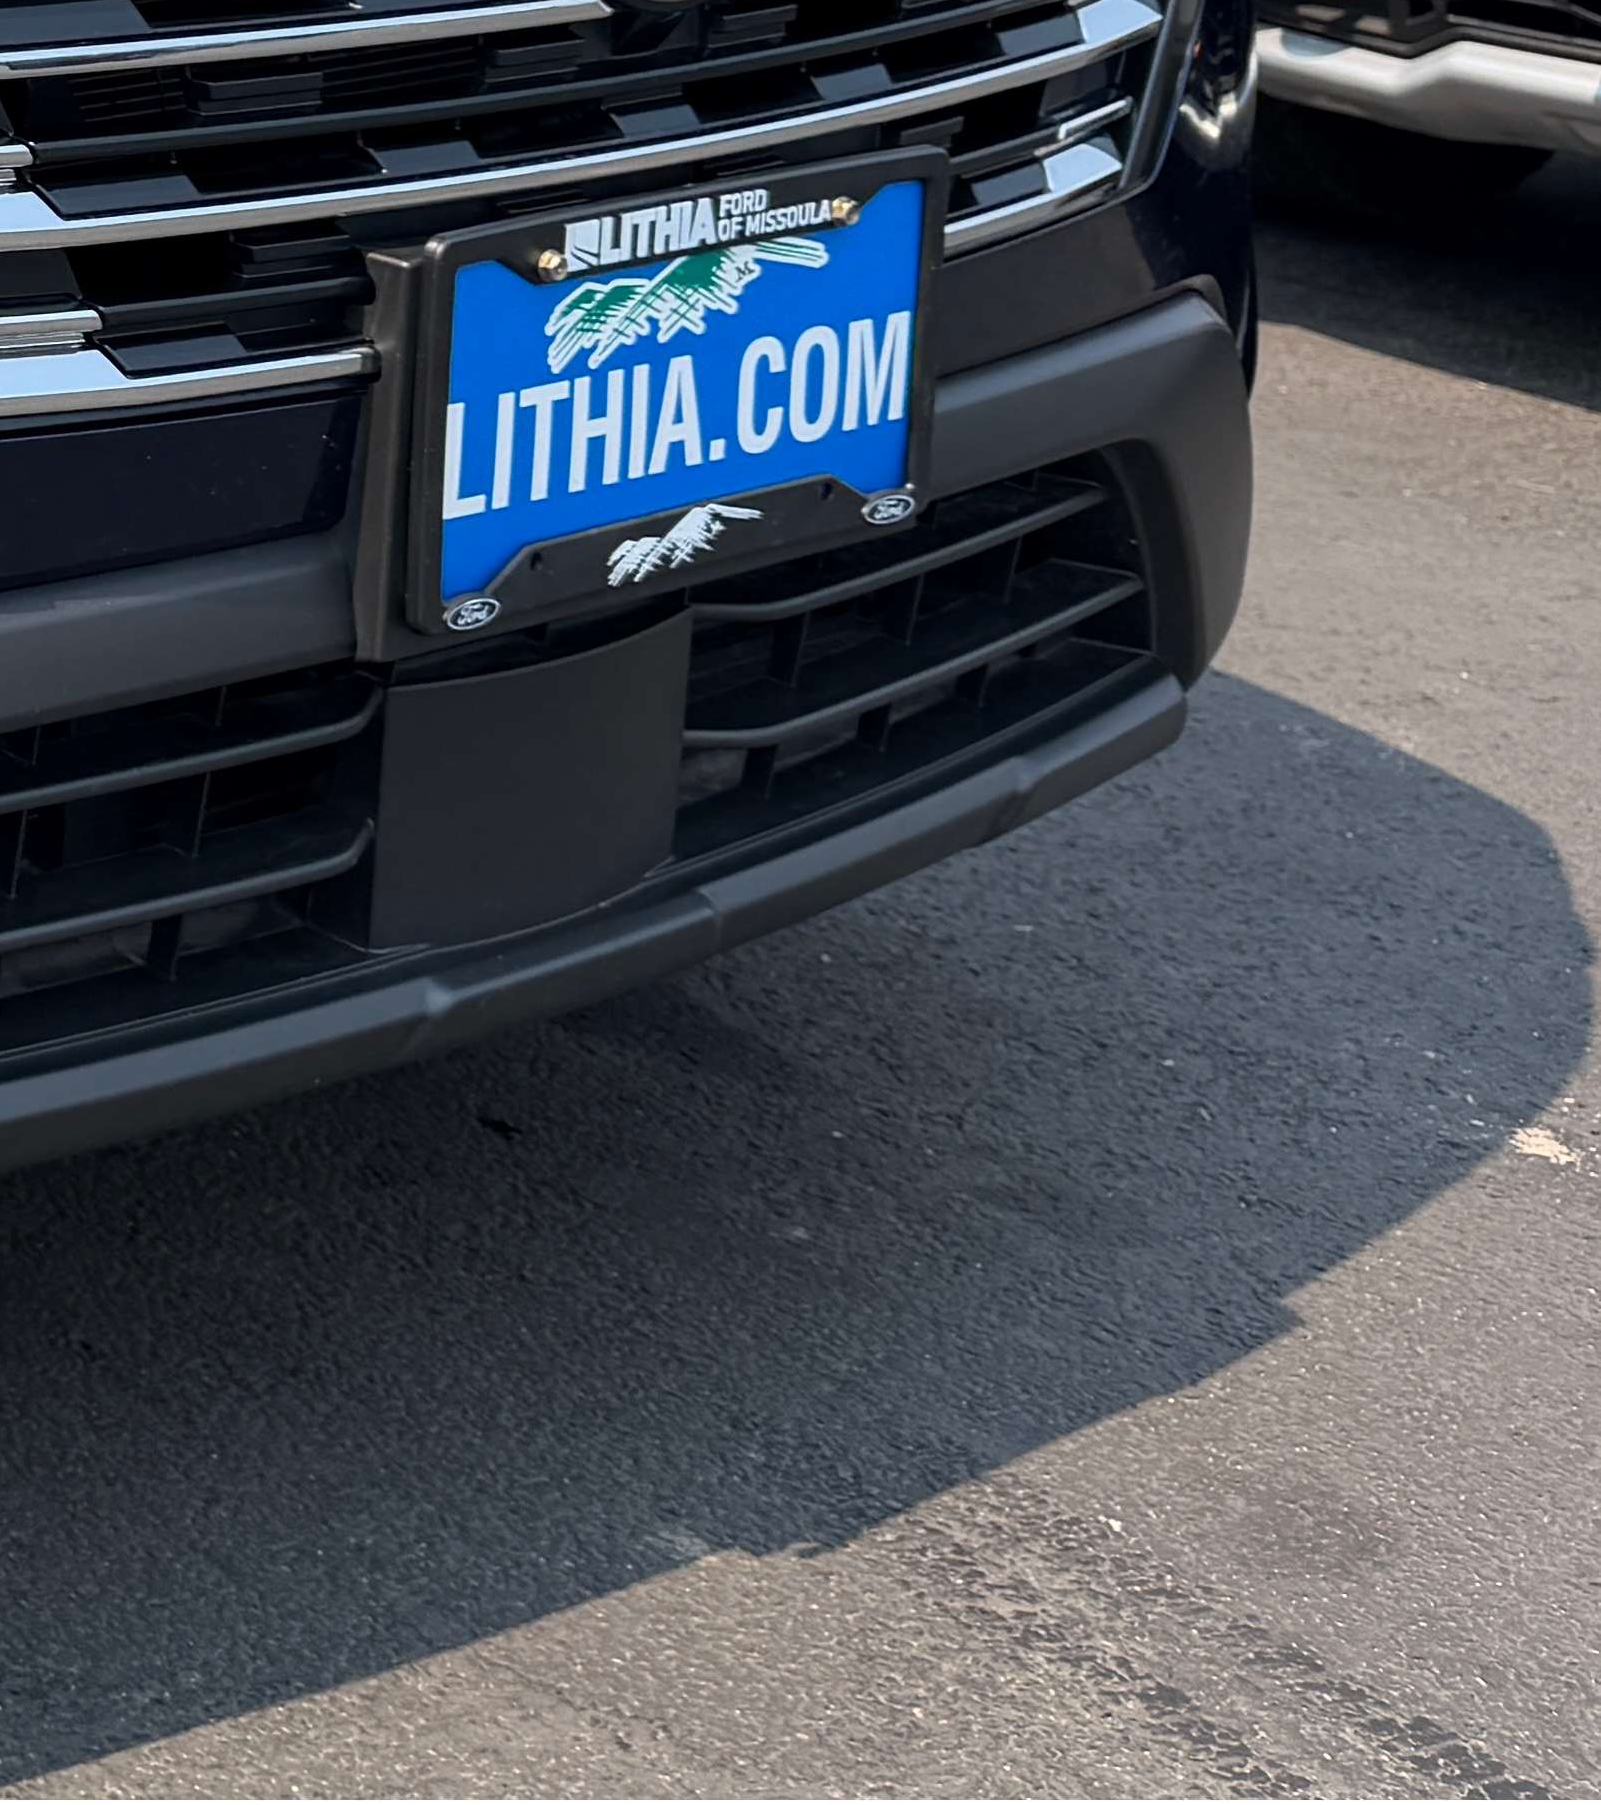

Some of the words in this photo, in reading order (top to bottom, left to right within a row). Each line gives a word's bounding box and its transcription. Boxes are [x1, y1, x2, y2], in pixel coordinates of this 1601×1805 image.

[600, 197, 717, 265] LITHIA
[718, 217, 744, 242] OF
[748, 199, 832, 237] MISSOULA
[719, 189, 769, 218] FORD
[442, 311, 912, 521] LITHIA.COM
